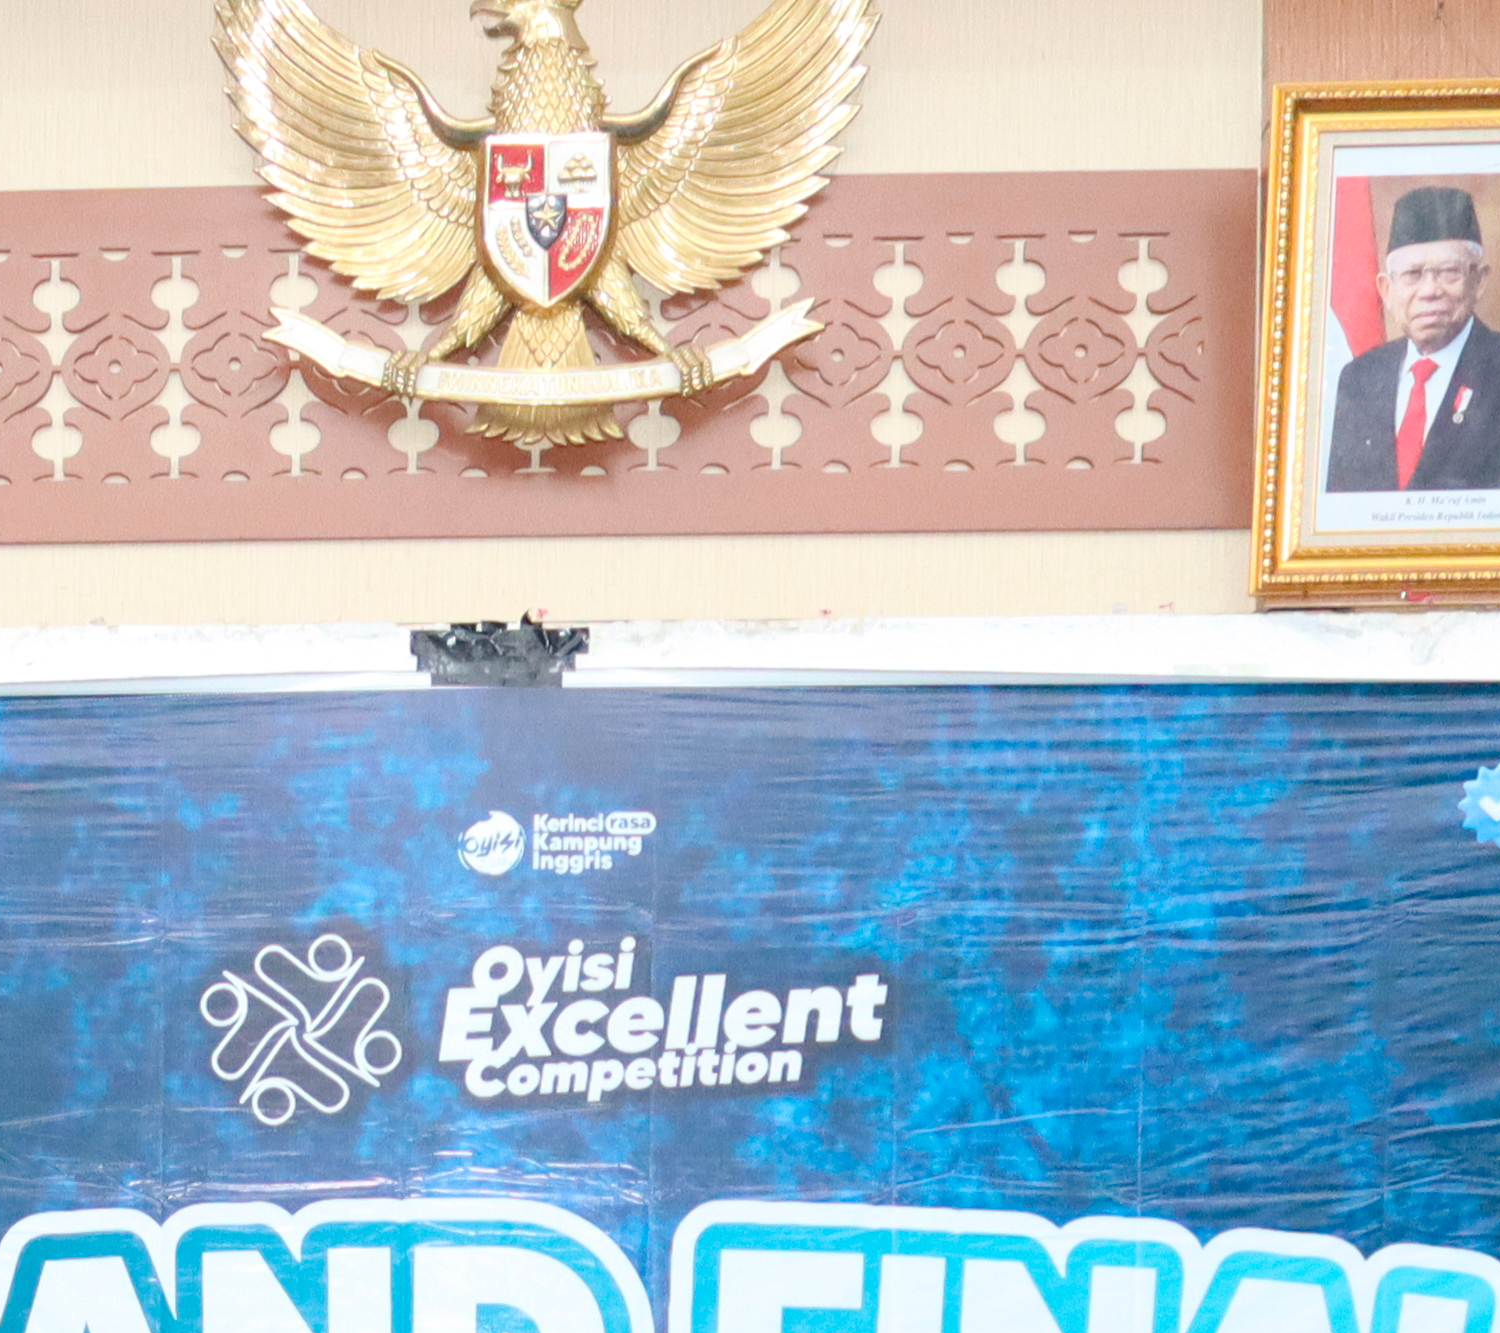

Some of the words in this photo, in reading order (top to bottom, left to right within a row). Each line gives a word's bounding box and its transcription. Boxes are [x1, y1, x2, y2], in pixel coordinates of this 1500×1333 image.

[533, 813, 604, 832] Kerinci
[608, 816, 651, 829] rasa
[532, 853, 613, 875] Inggris
[533, 835, 642, 856] Kampung
[471, 936, 638, 1006] Oyisi
[438, 973, 889, 1063] Excellent
[465, 1042, 802, 1102] Competition
